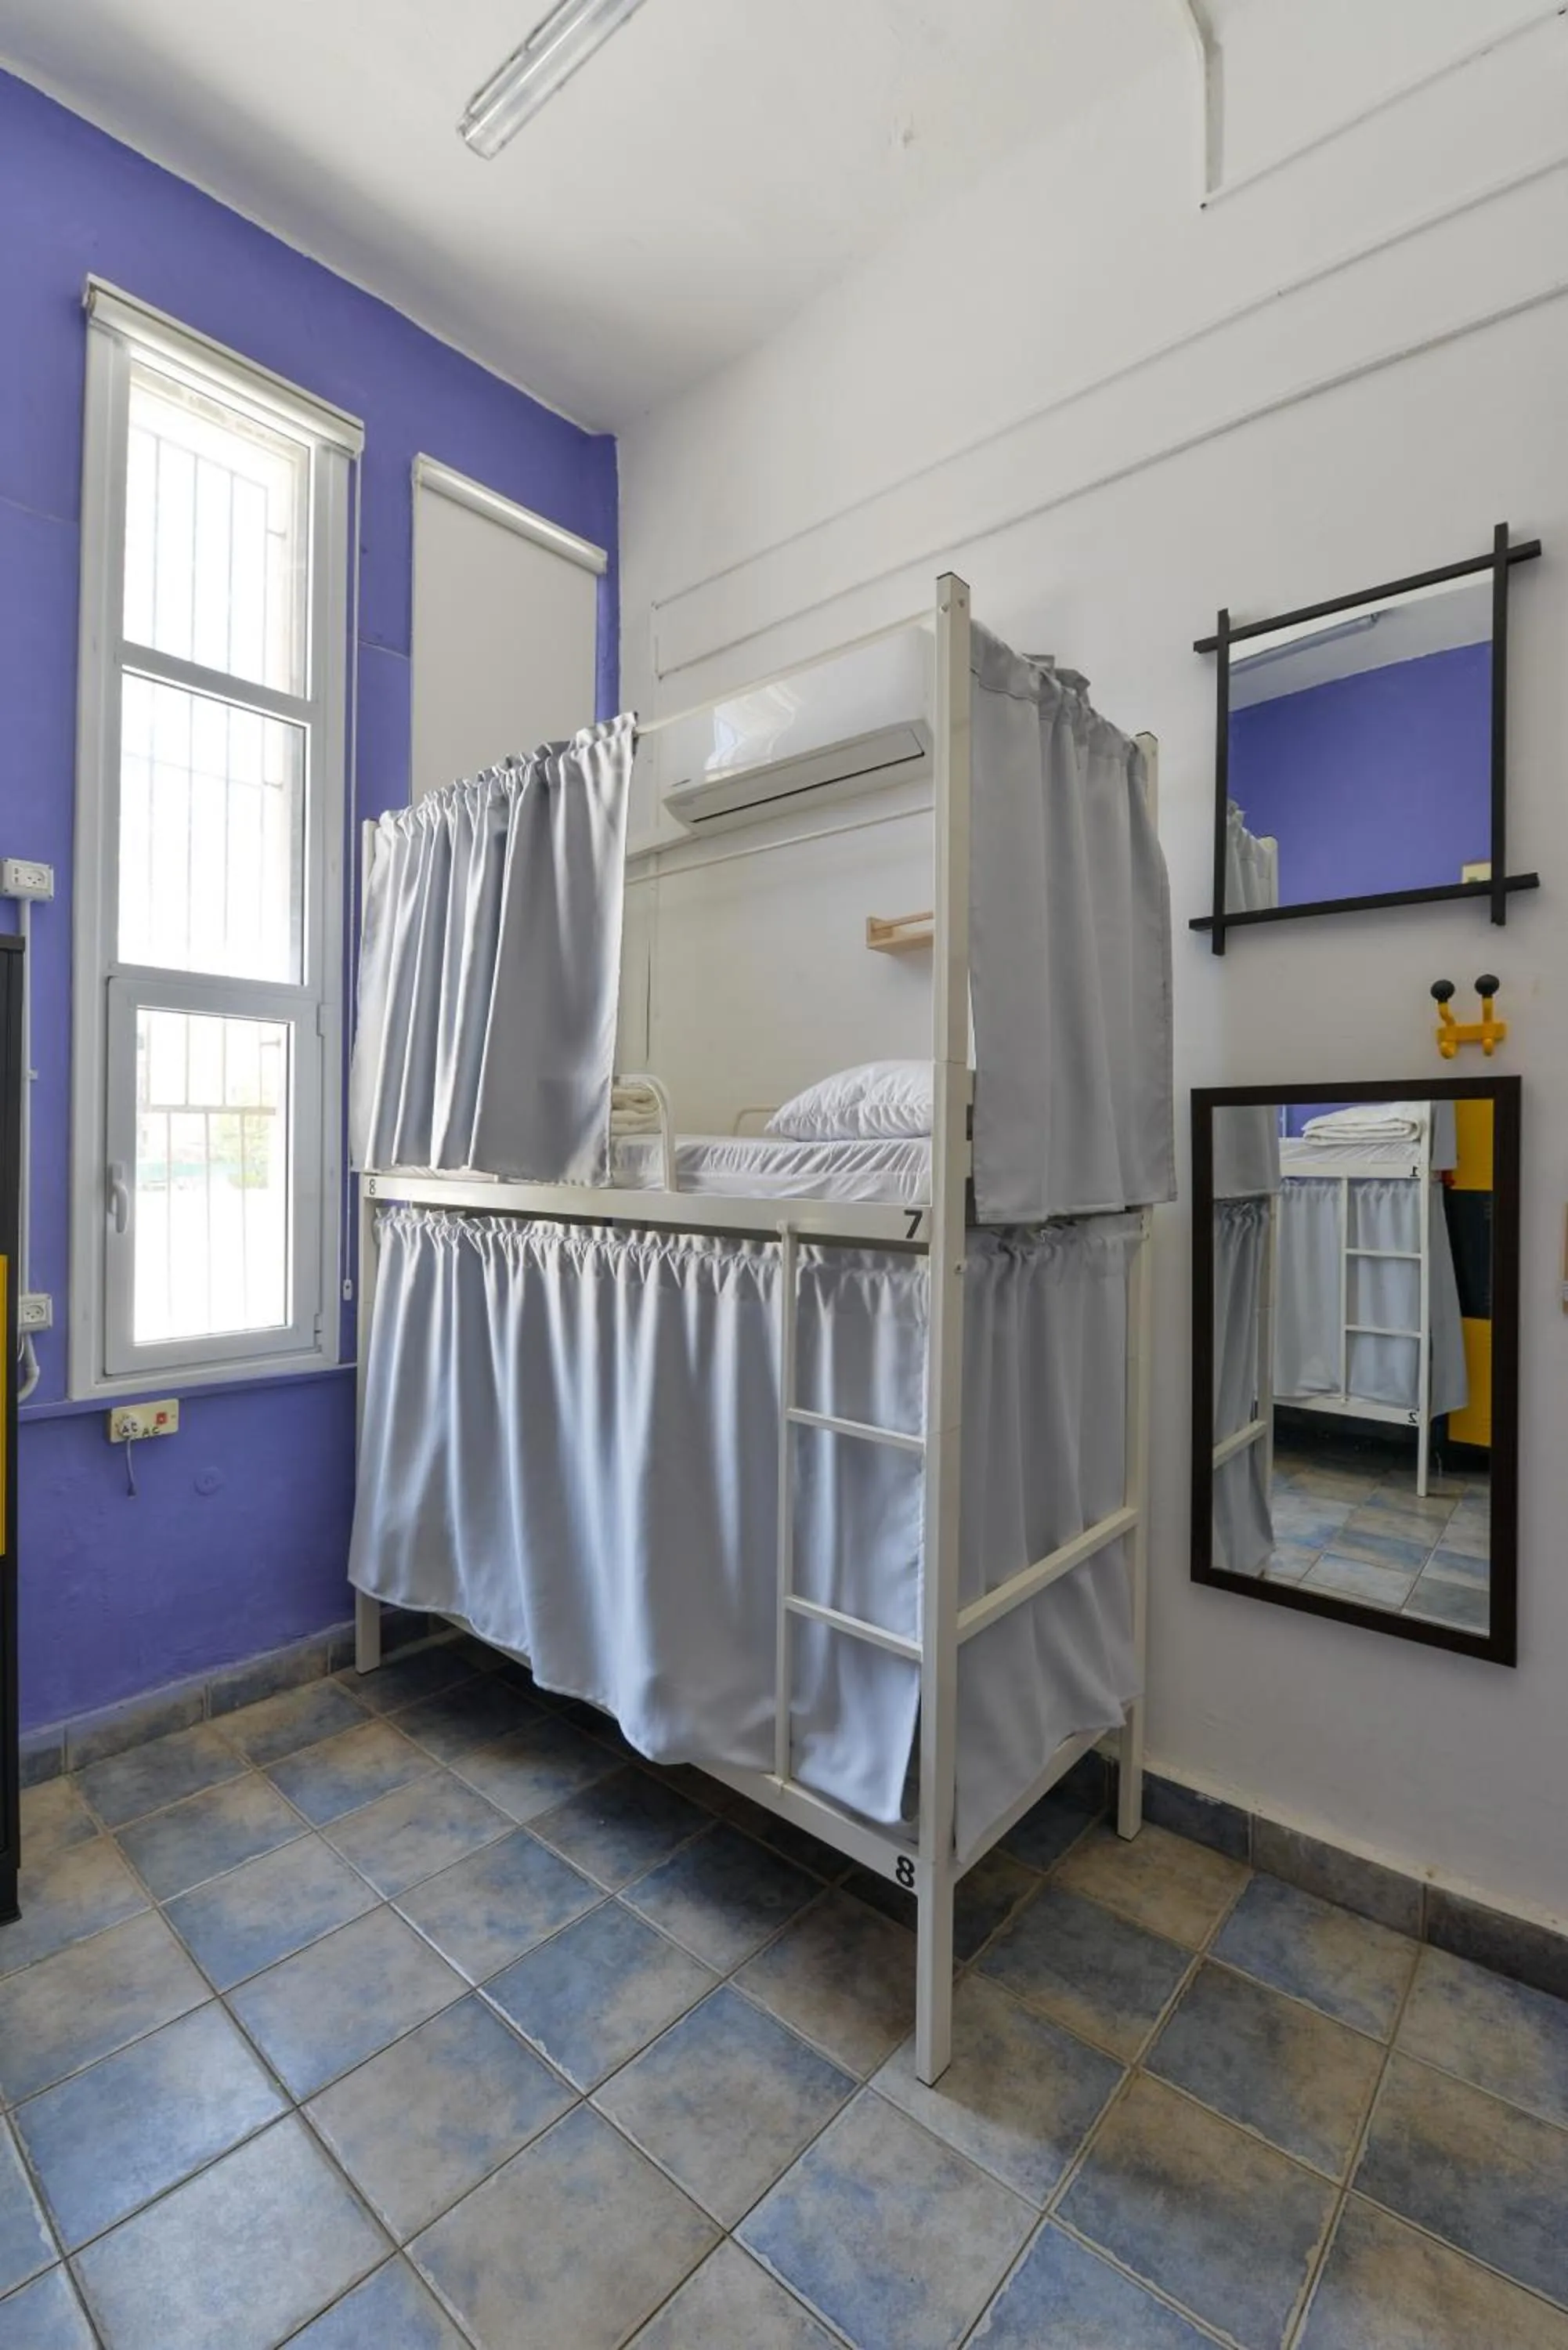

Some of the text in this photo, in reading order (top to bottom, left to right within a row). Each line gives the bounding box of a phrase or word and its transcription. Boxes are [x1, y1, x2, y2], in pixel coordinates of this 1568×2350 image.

[369, 1178, 376, 1195] 8
[904, 1209, 923, 1238] 7
[895, 1854, 915, 1889] 8
